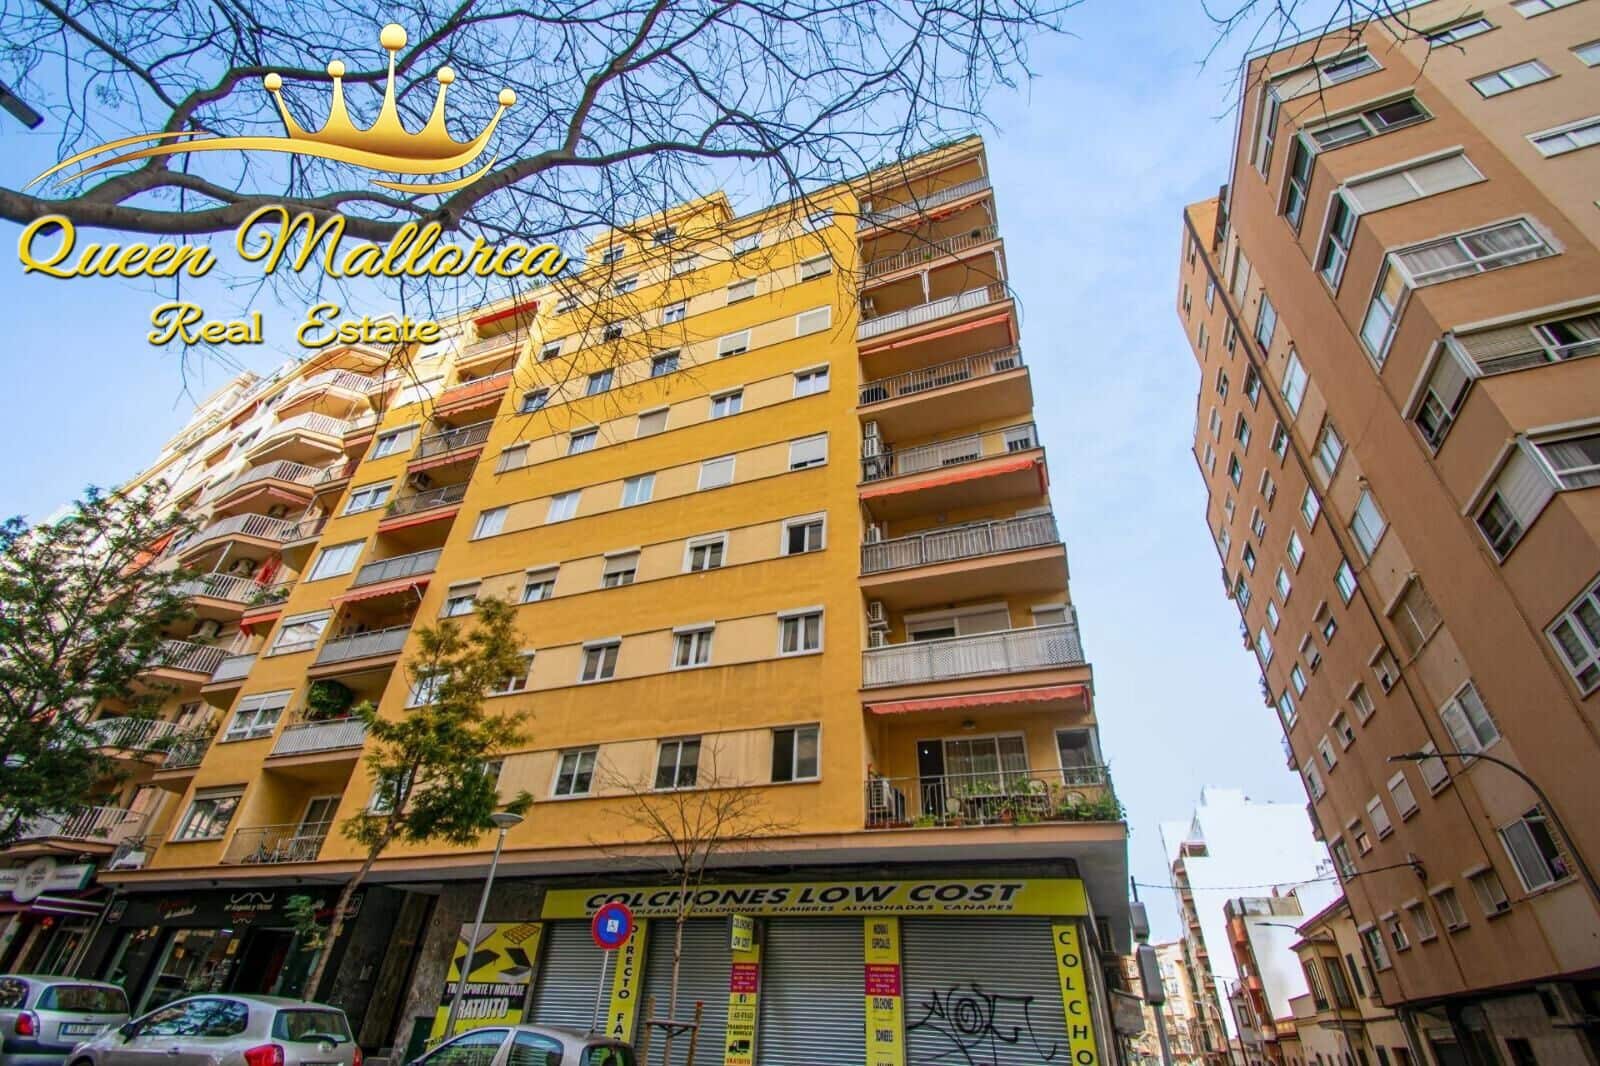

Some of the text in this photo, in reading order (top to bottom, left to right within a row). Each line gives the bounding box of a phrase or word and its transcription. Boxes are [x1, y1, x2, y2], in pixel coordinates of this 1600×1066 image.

[586, 884, 1023, 908] COLCHONES LOW COST
[692, 905, 764, 913] COLCHONES
[618, 925, 639, 999] DIRECTO
[447, 983, 489, 995] TRSPORTE
[1058, 931, 1094, 1066] COLCHO
[449, 997, 509, 1019] RATUITO
